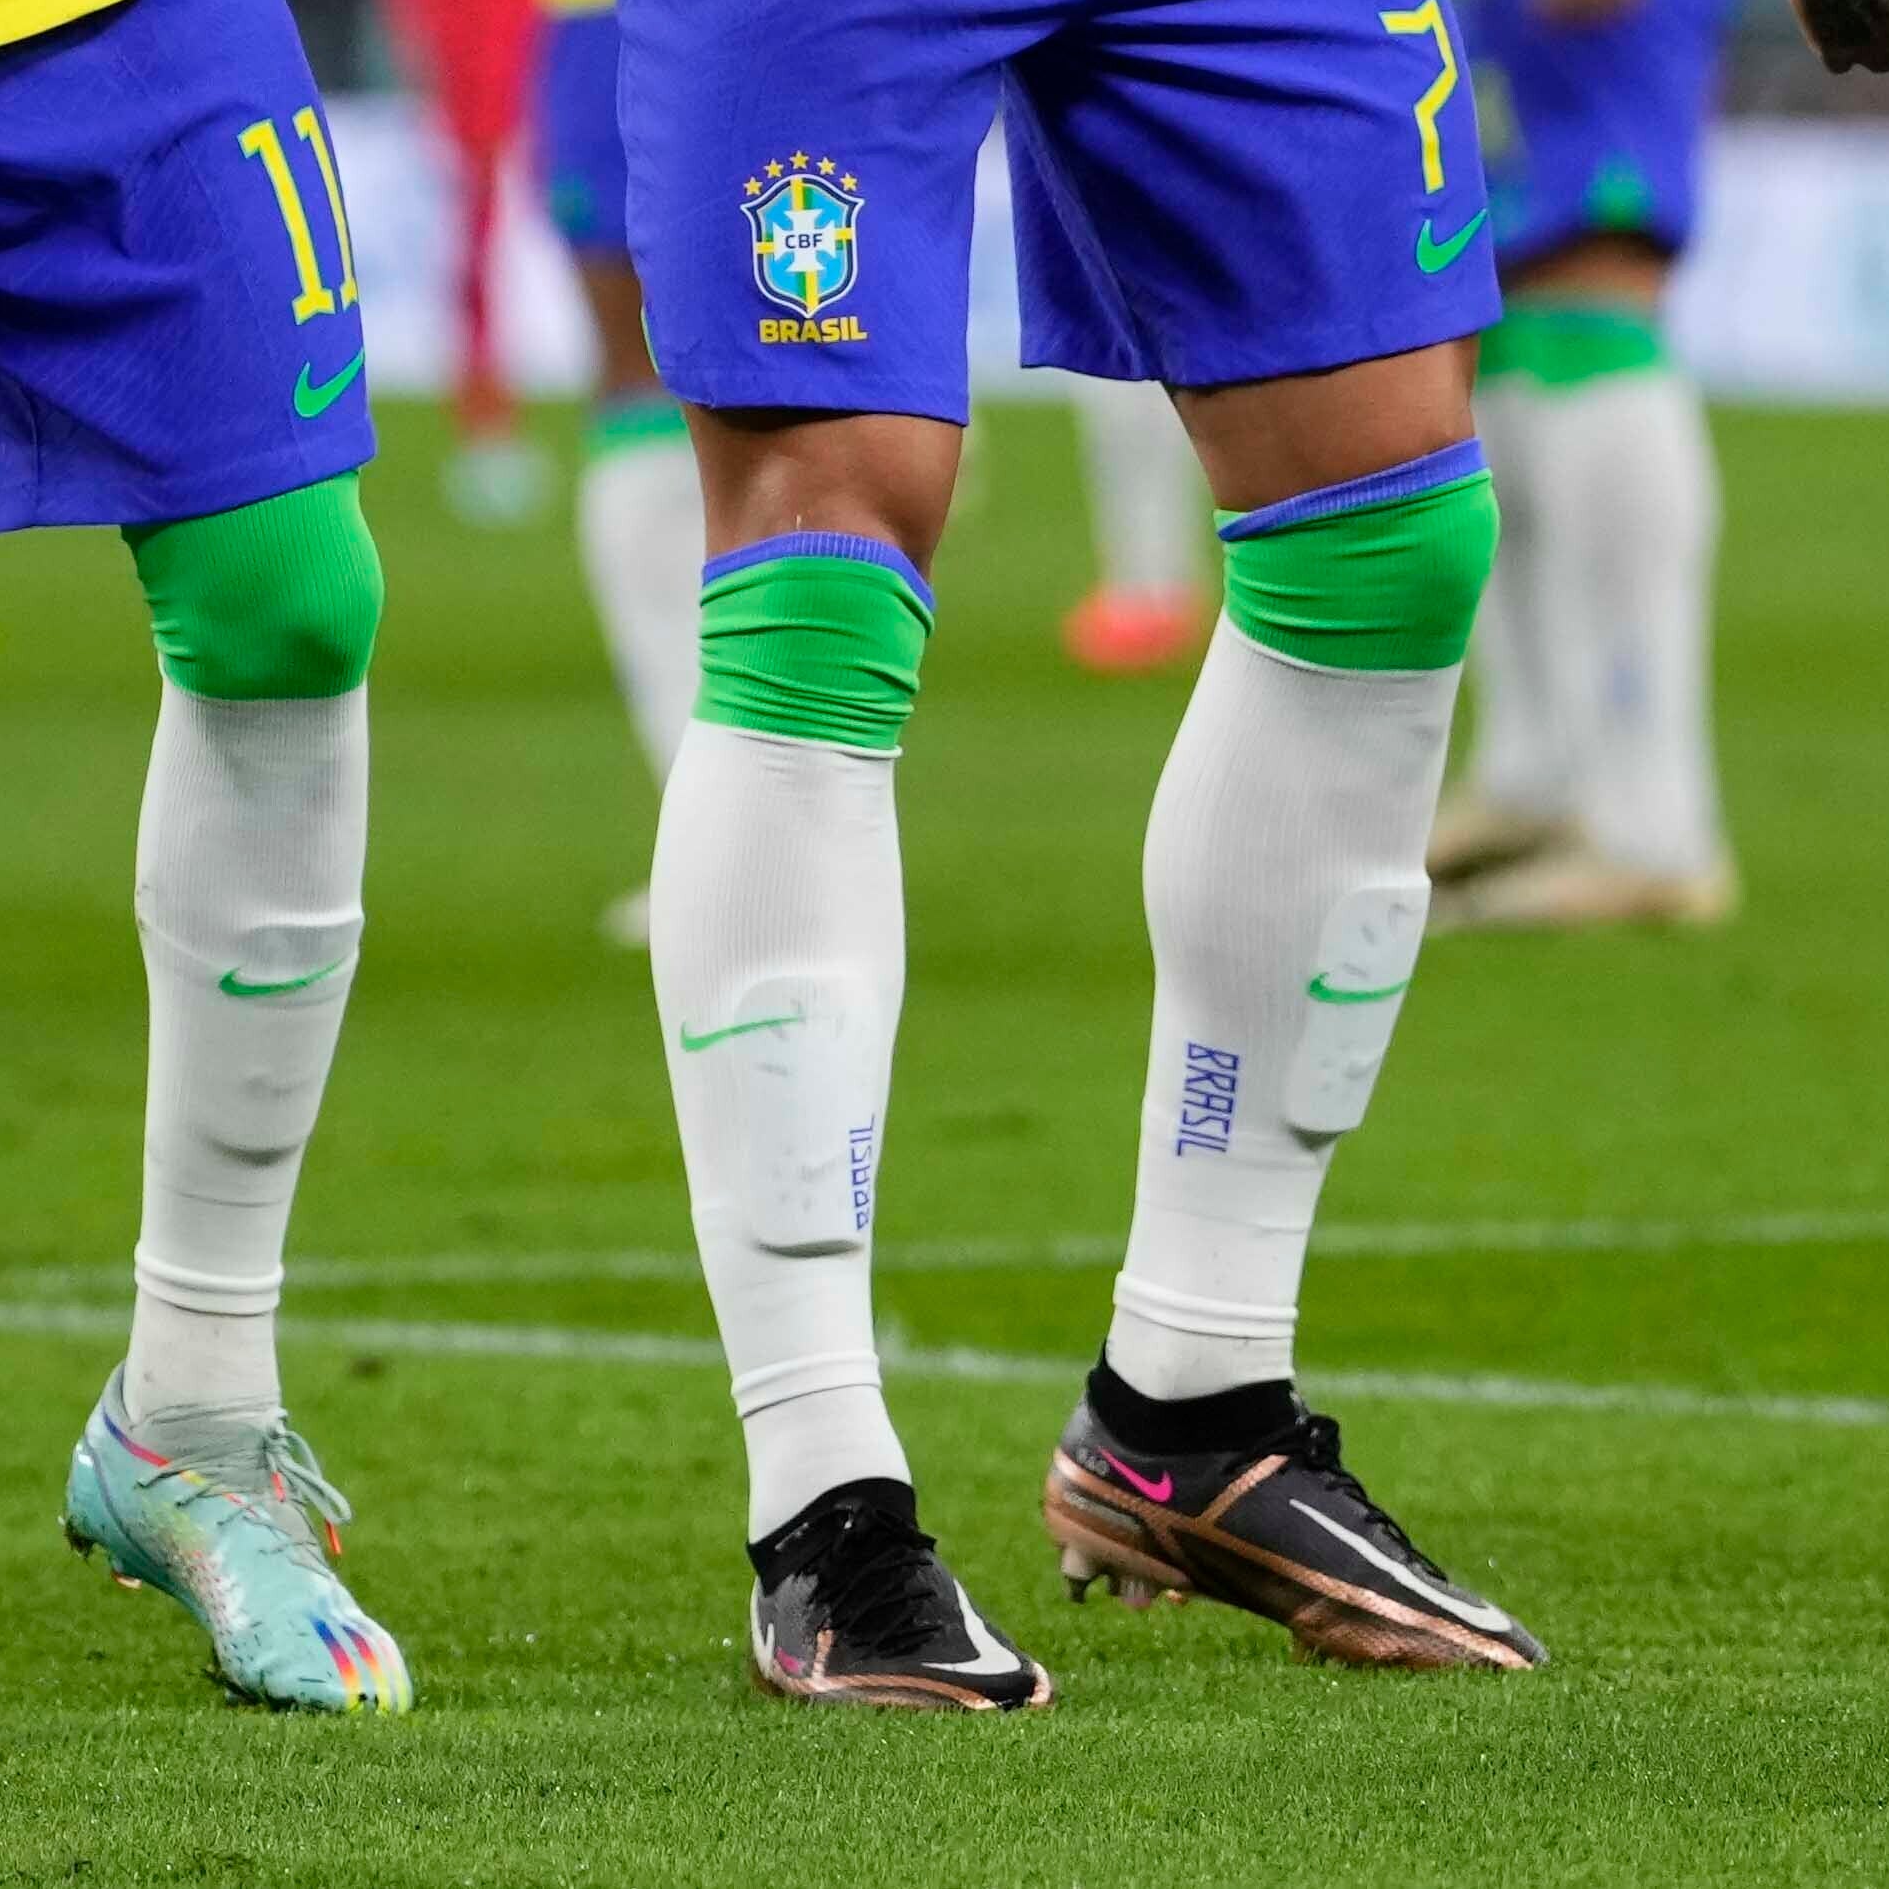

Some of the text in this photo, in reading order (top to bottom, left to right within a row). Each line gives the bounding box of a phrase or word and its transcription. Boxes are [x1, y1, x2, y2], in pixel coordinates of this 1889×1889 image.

[236, 105, 359, 326] 11
[785, 233, 823, 250] CBF
[758, 315, 869, 344] BRASIL
[1177, 1041, 1240, 1157] BRASIL
